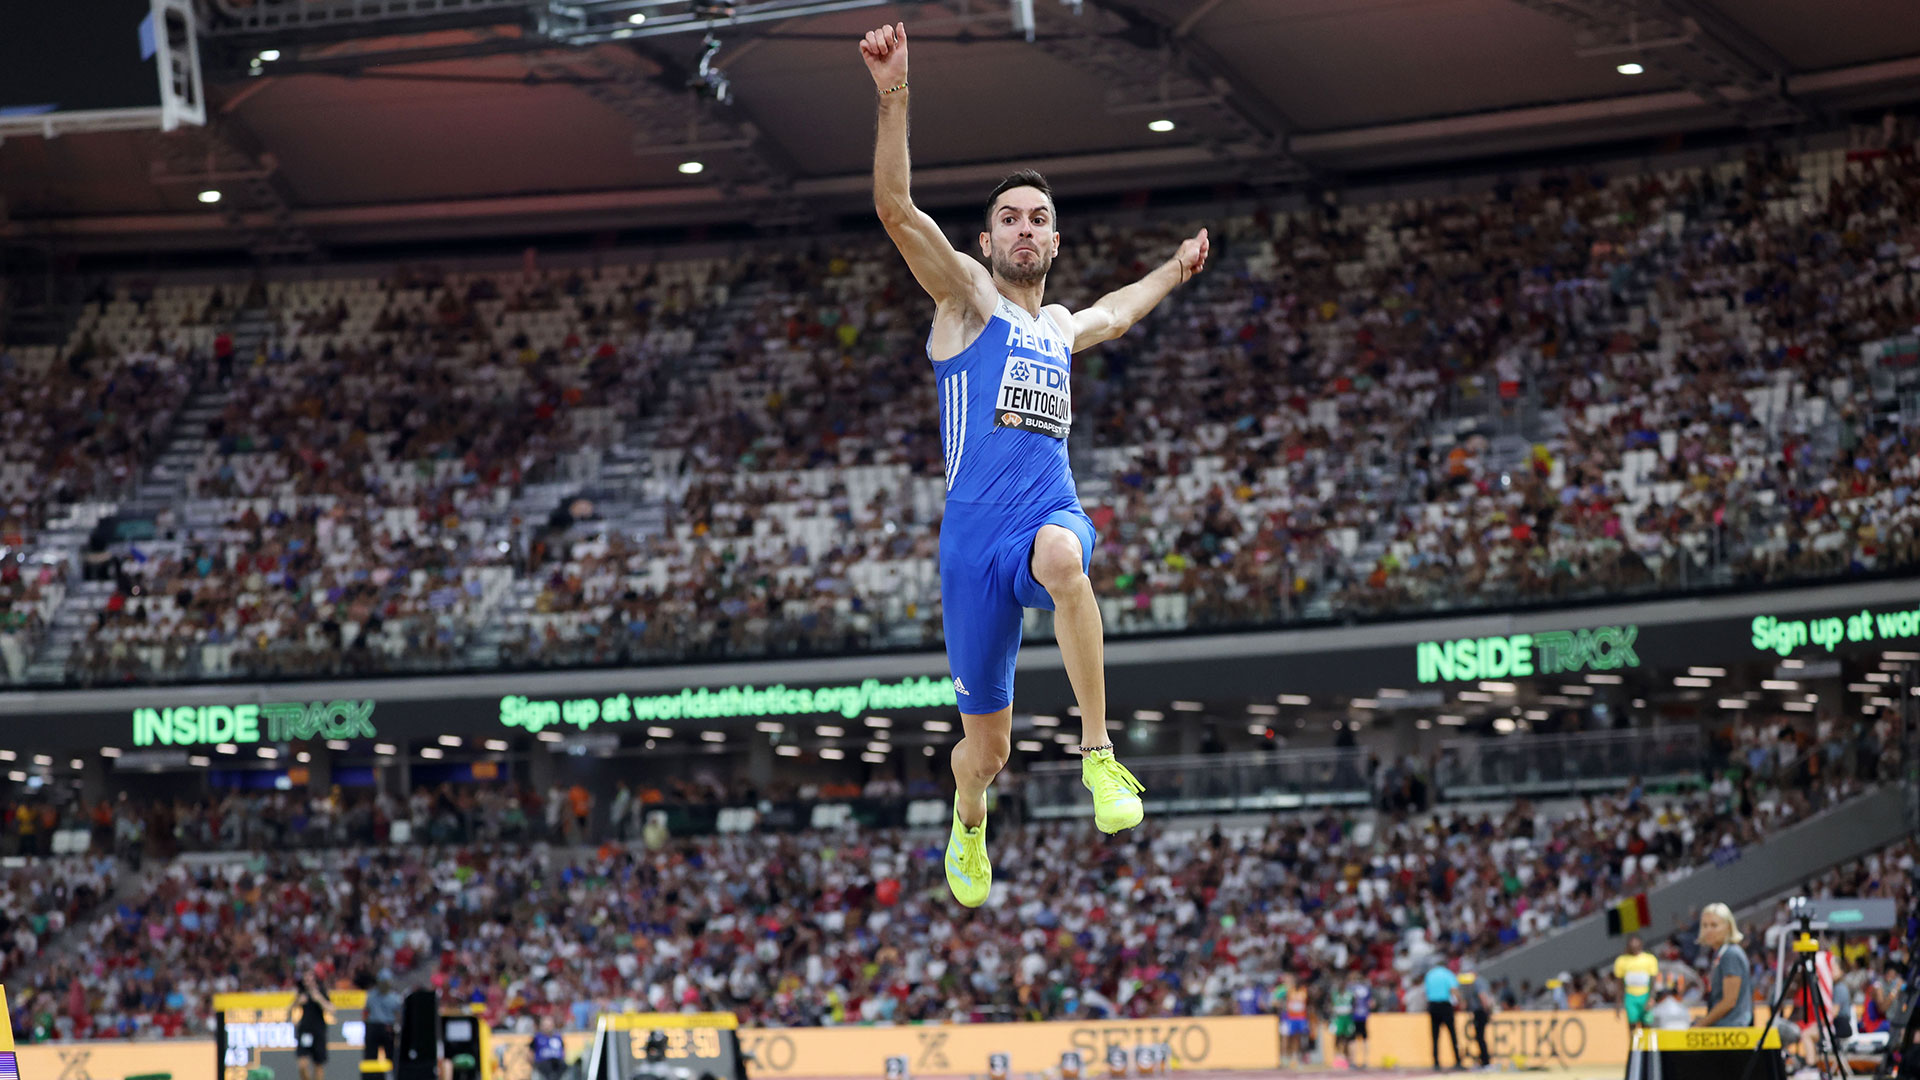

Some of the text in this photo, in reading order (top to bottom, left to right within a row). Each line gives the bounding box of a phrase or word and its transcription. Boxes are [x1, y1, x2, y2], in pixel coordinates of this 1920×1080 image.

[1030, 363, 1068, 394] TDK
[1003, 386, 1068, 421] TENTOGLOU
[1025, 418, 1063, 434] BUDAPEST
[1751, 615, 1808, 656] Sign
[1810, 617, 1845, 652] up
[1847, 609, 1874, 641] at
[1417, 624, 1641, 683] INSIDE TRACK
[133, 699, 377, 746] INSIDE TRACK
[499, 695, 561, 733] Sign
[562, 697, 600, 731] up
[601, 692, 631, 723] at
[1685, 1030, 1750, 1049] SEIKO
